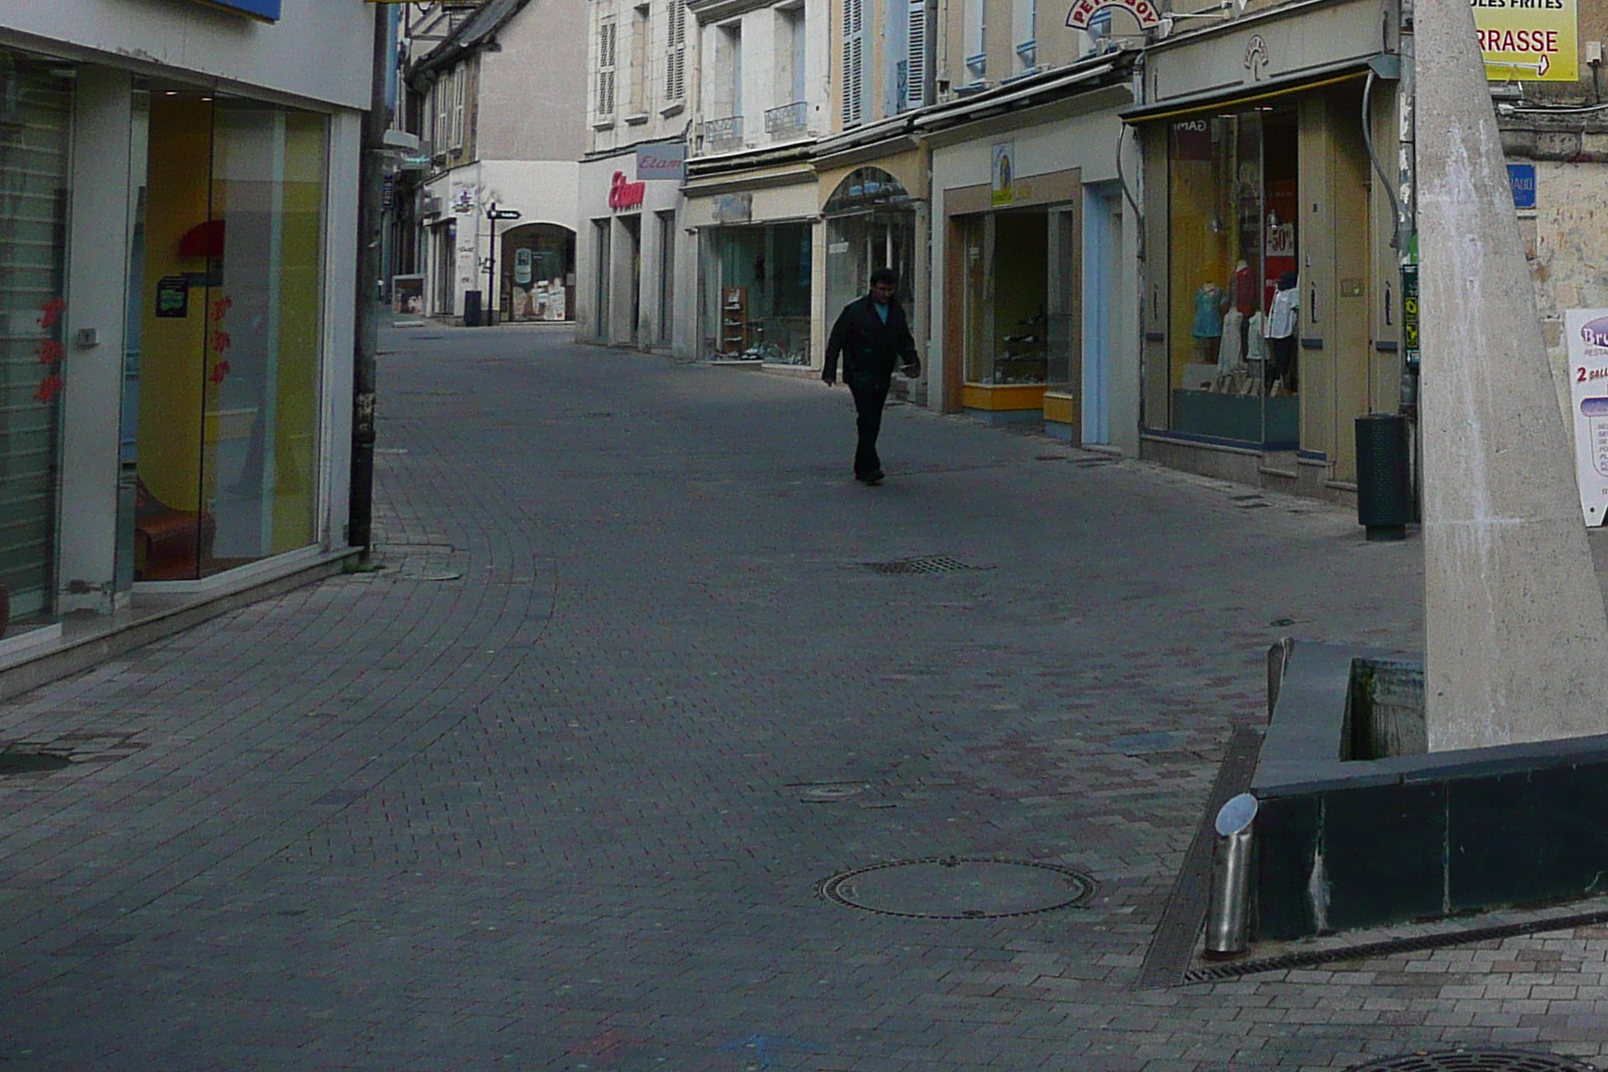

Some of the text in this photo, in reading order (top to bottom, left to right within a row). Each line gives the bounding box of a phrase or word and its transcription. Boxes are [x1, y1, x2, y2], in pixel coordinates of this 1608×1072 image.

[1476, 29, 1559, 52] RRASSE
[639, 155, 683, 170] Etam
[1577, 367, 1588, 383] 2
